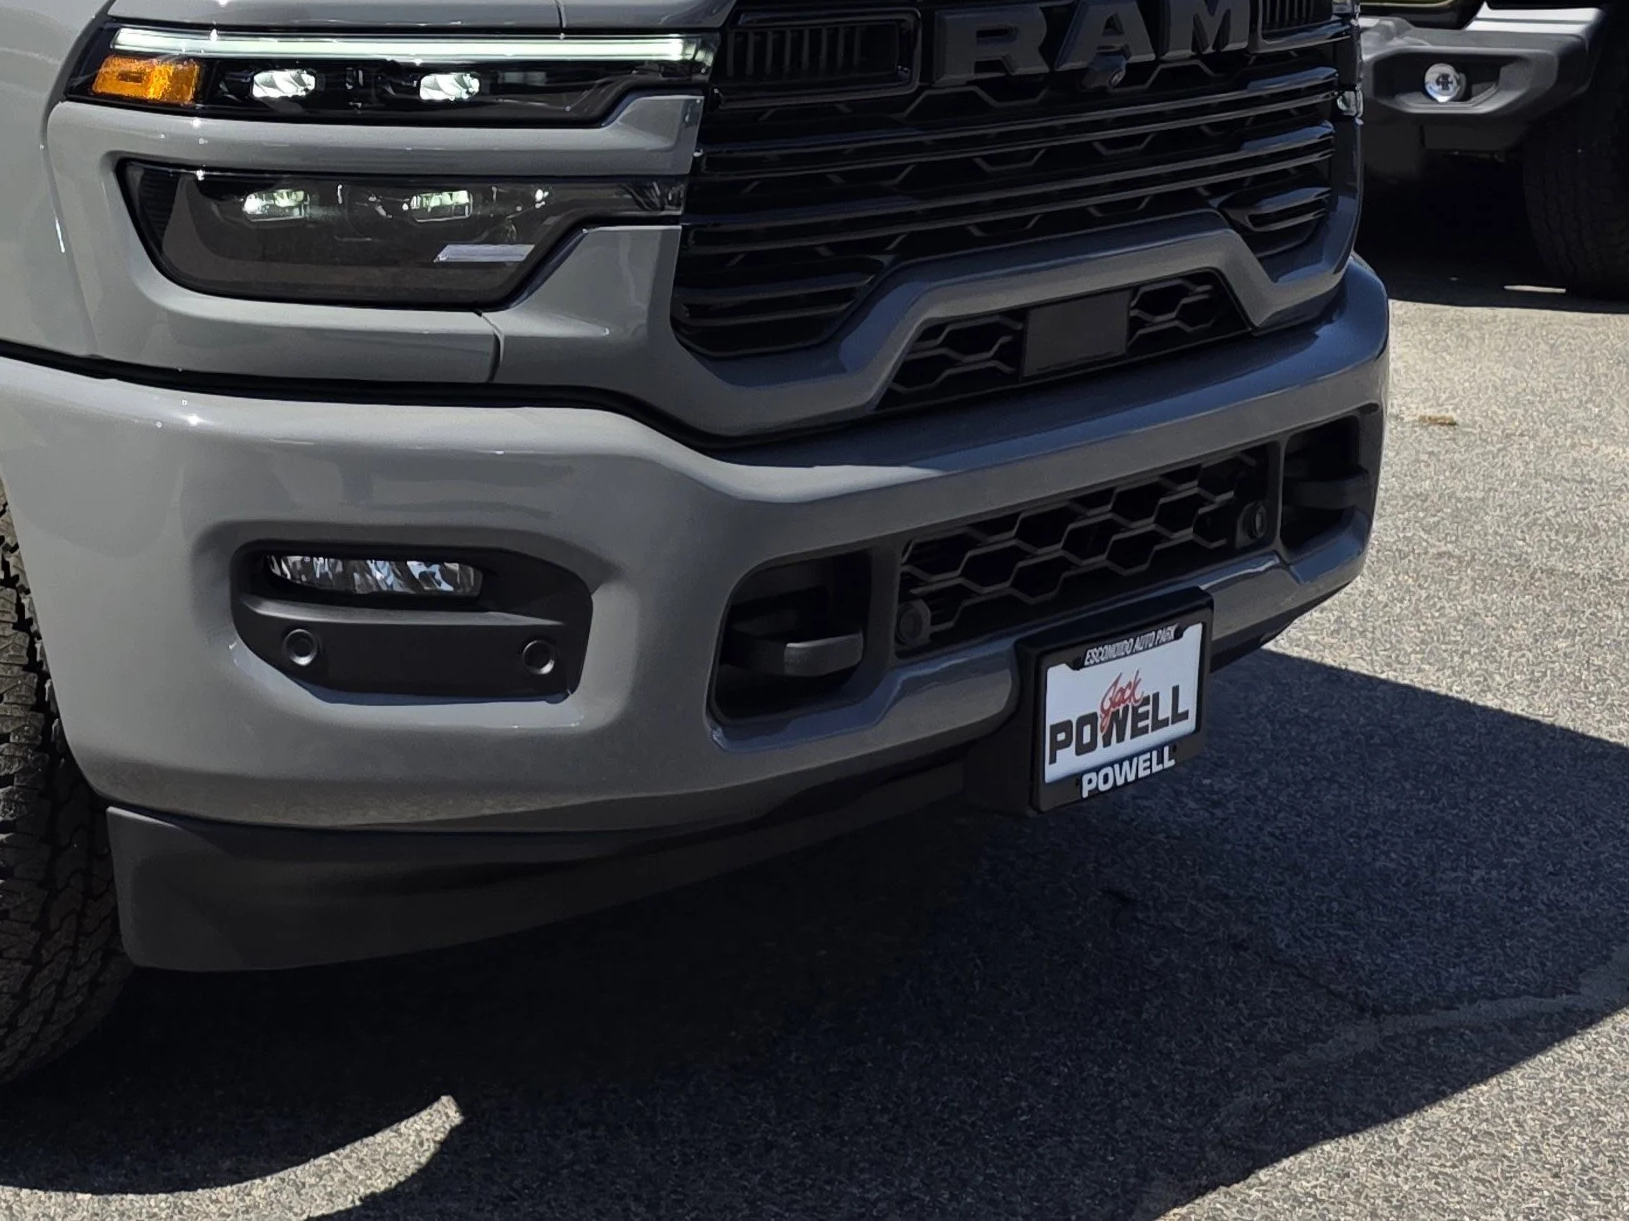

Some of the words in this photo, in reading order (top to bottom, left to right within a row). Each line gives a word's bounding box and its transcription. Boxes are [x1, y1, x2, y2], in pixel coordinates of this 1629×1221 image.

[1049, 684, 1189, 765] POWELL
[1100, 669, 1144, 734] Jack
[1081, 745, 1176, 798] POWELL
